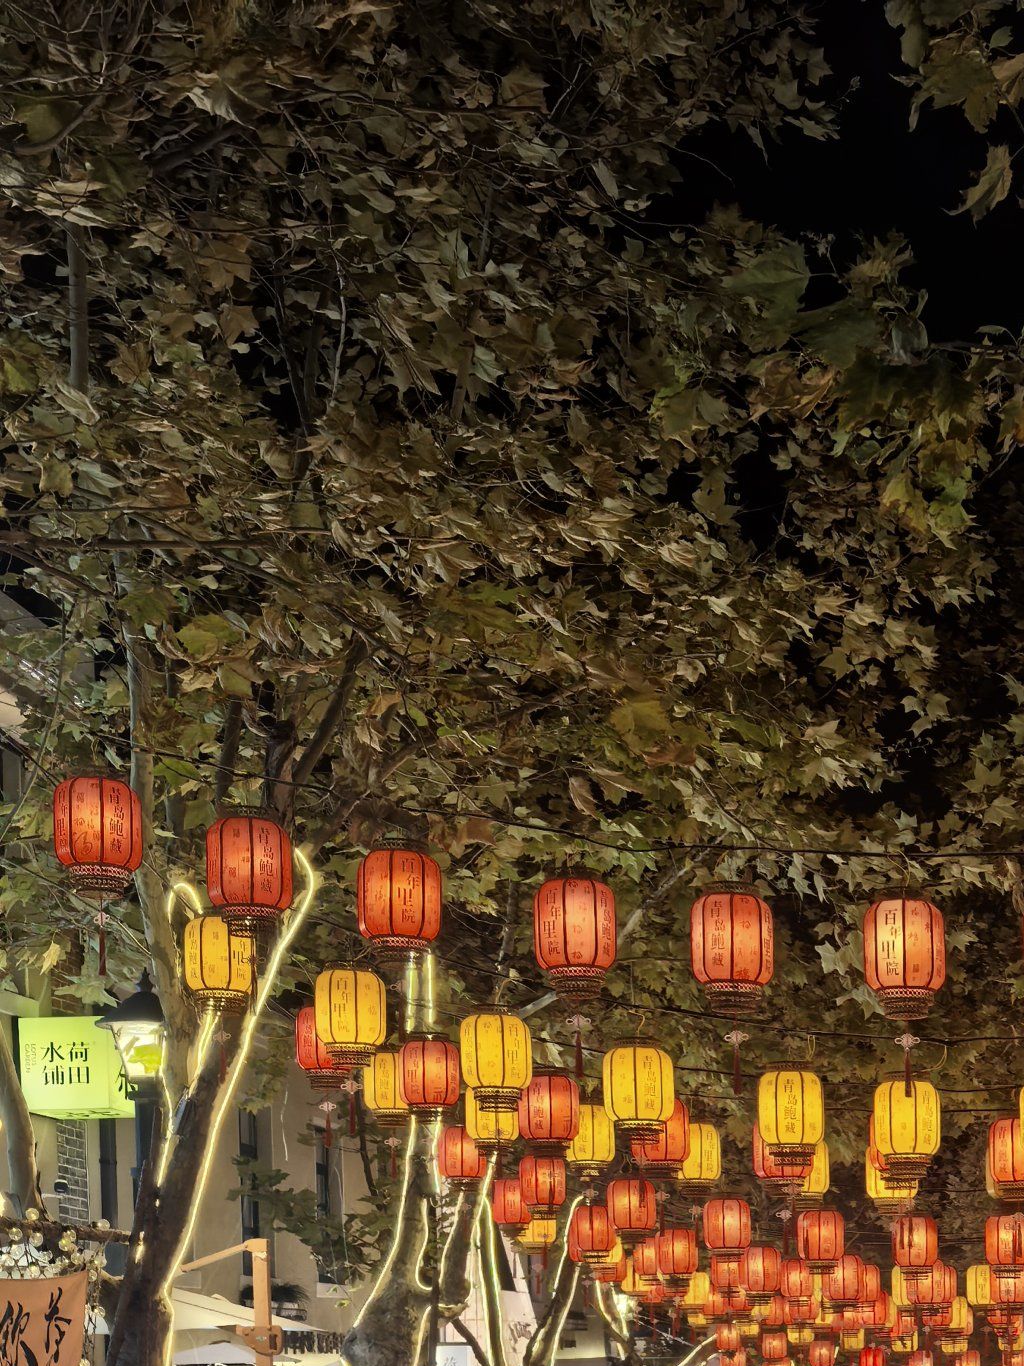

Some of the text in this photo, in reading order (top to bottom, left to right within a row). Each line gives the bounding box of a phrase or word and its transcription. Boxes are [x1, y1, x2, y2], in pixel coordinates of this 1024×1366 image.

[109, 787, 126, 853] 青岛鲍藏
[398, 858, 421, 924] 百年里院
[543, 888, 562, 955] 百年里院
[881, 908, 902, 976] 百年里院
[783, 1078, 797, 1134] 青岛鲍藏
